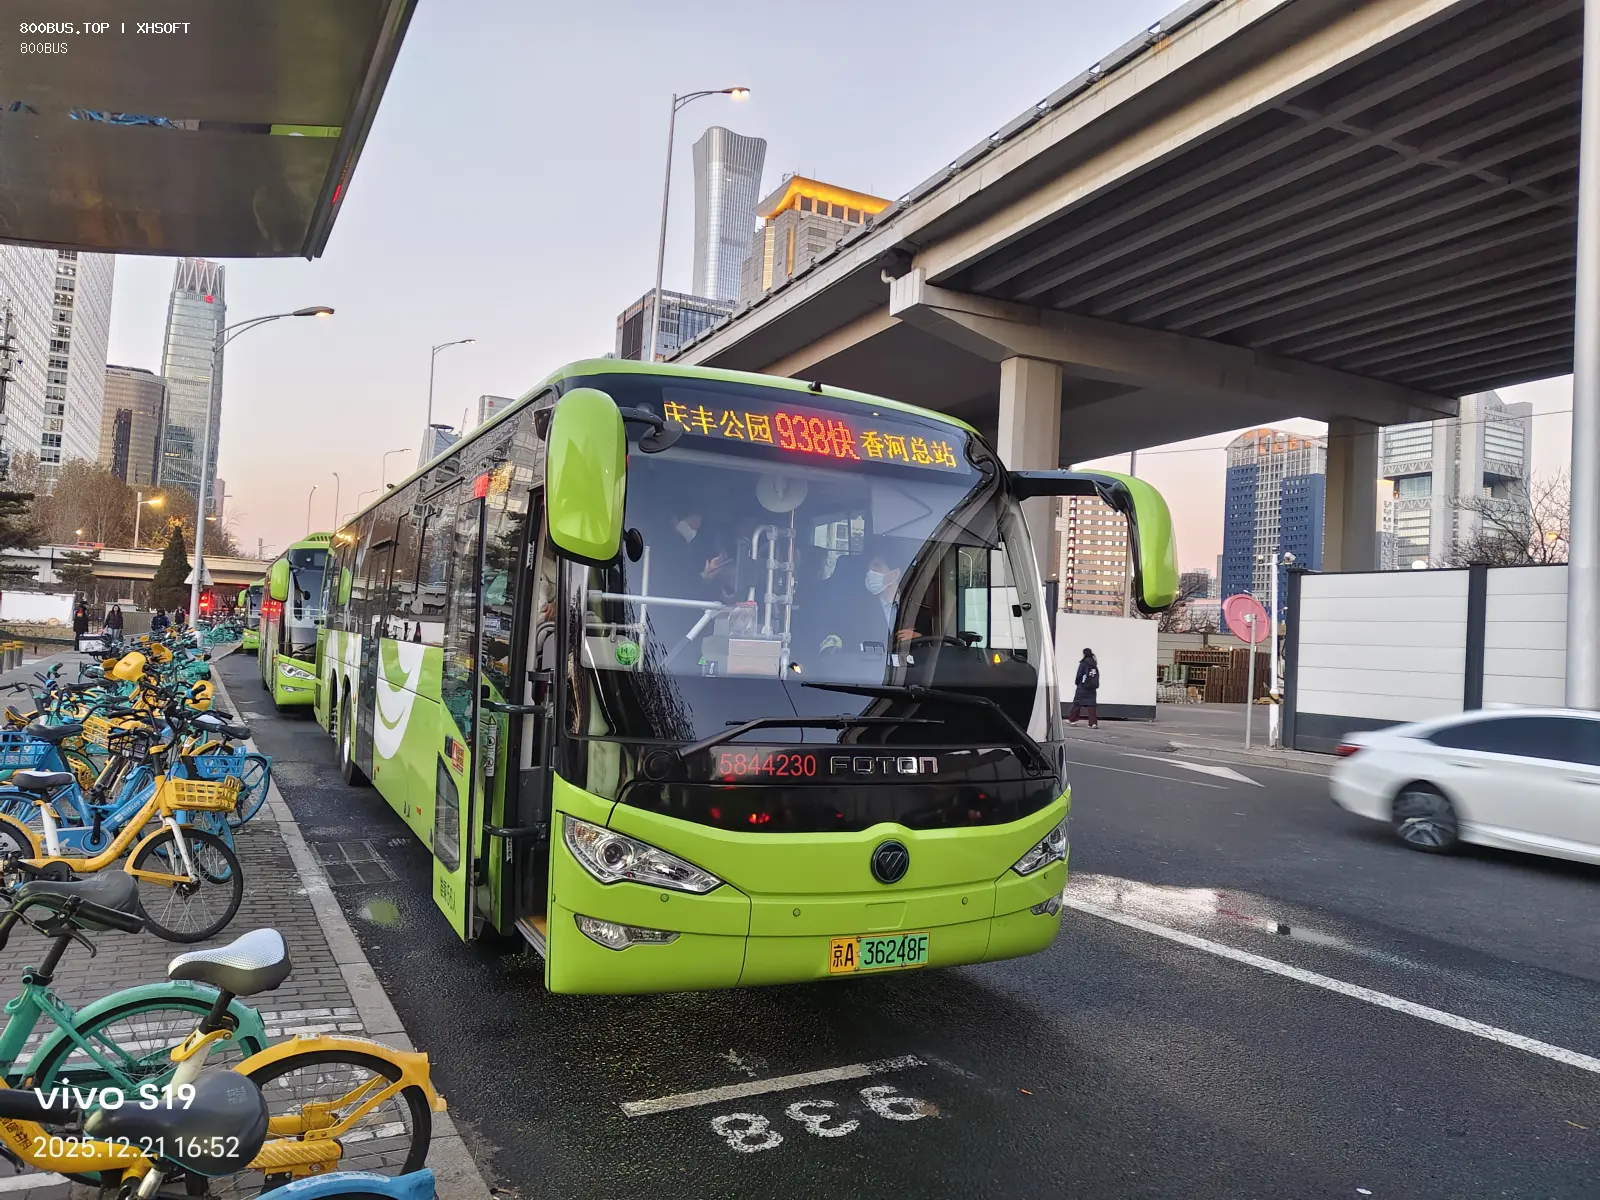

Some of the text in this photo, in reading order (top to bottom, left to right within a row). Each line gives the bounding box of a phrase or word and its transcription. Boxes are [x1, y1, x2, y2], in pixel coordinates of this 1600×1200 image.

[663, 401, 957, 468] 庆丰公园 938快 香河总站
[719, 753, 939, 777] 5844230 FOTON
[833, 936, 928, 968] 京A 36248F
[710, 1085, 942, 1153] 938
